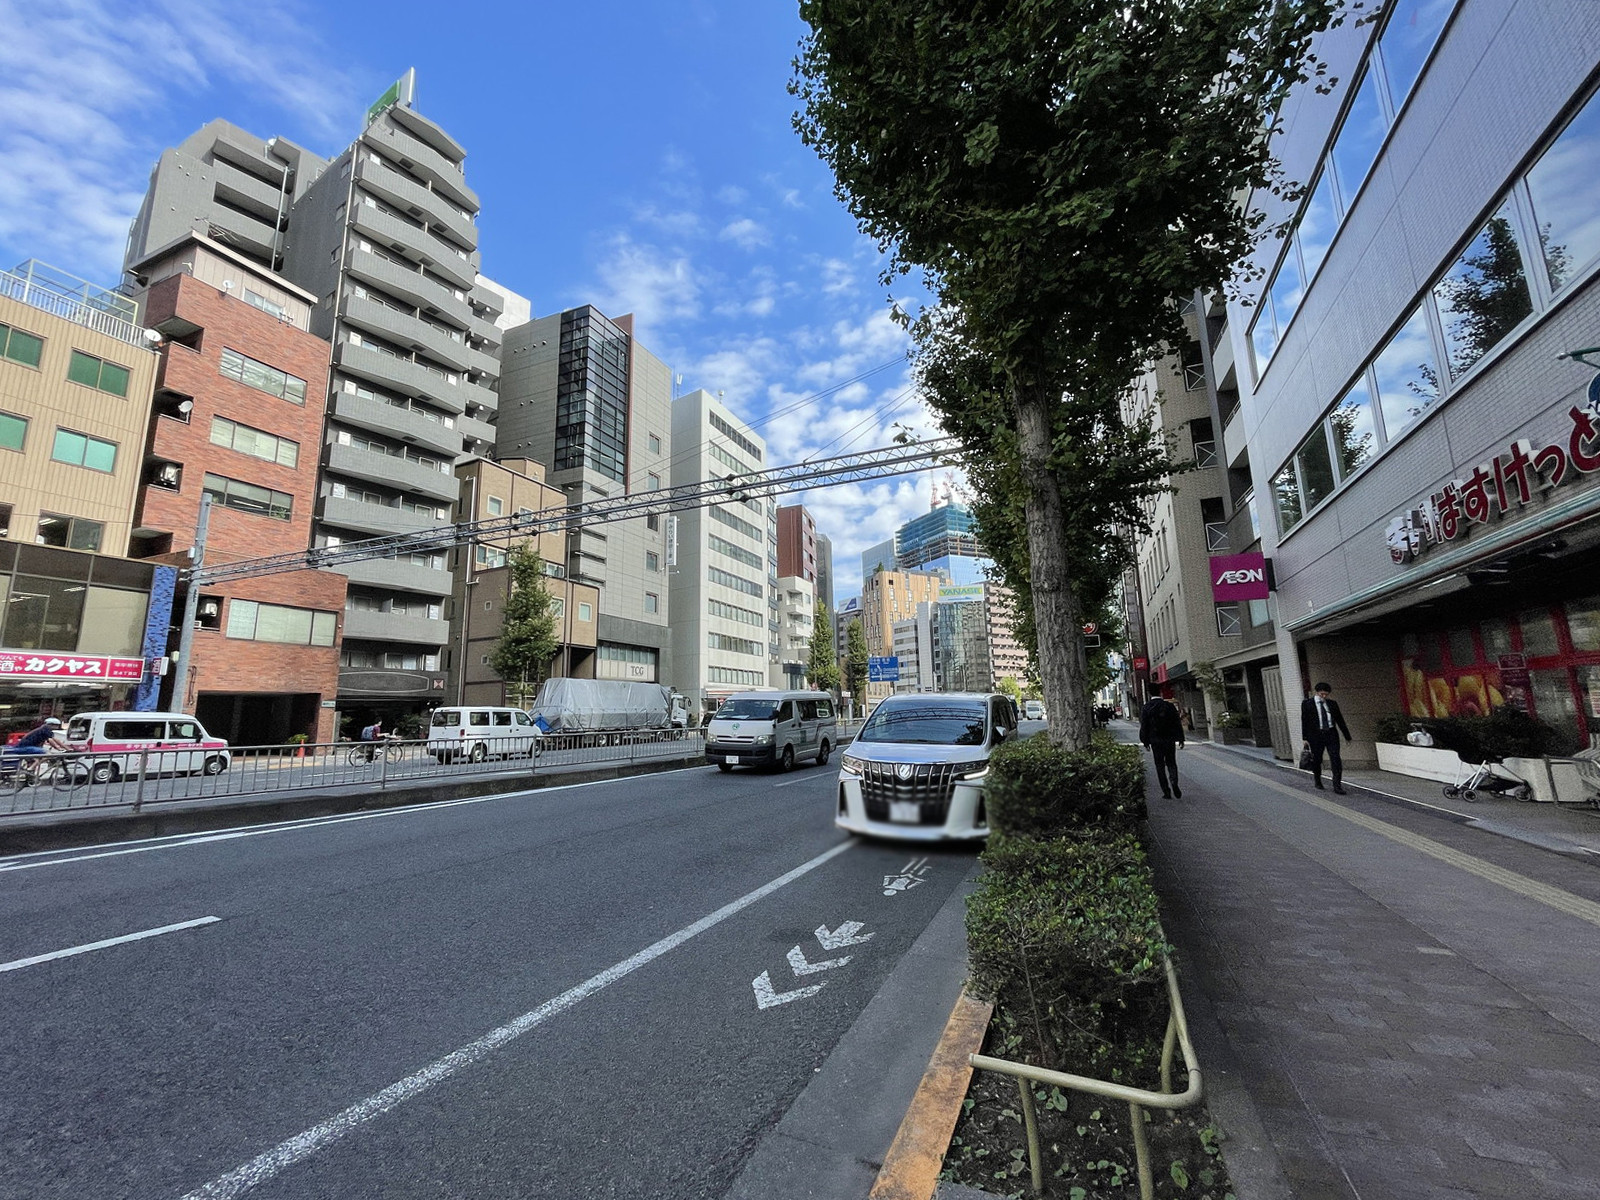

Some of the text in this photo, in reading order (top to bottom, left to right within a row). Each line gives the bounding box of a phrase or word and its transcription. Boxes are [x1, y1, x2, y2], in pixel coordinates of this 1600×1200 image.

[1216, 568, 1264, 586] AEON
[940, 587, 979, 596] YANASE
[24, 657, 102, 674] カクヤス
